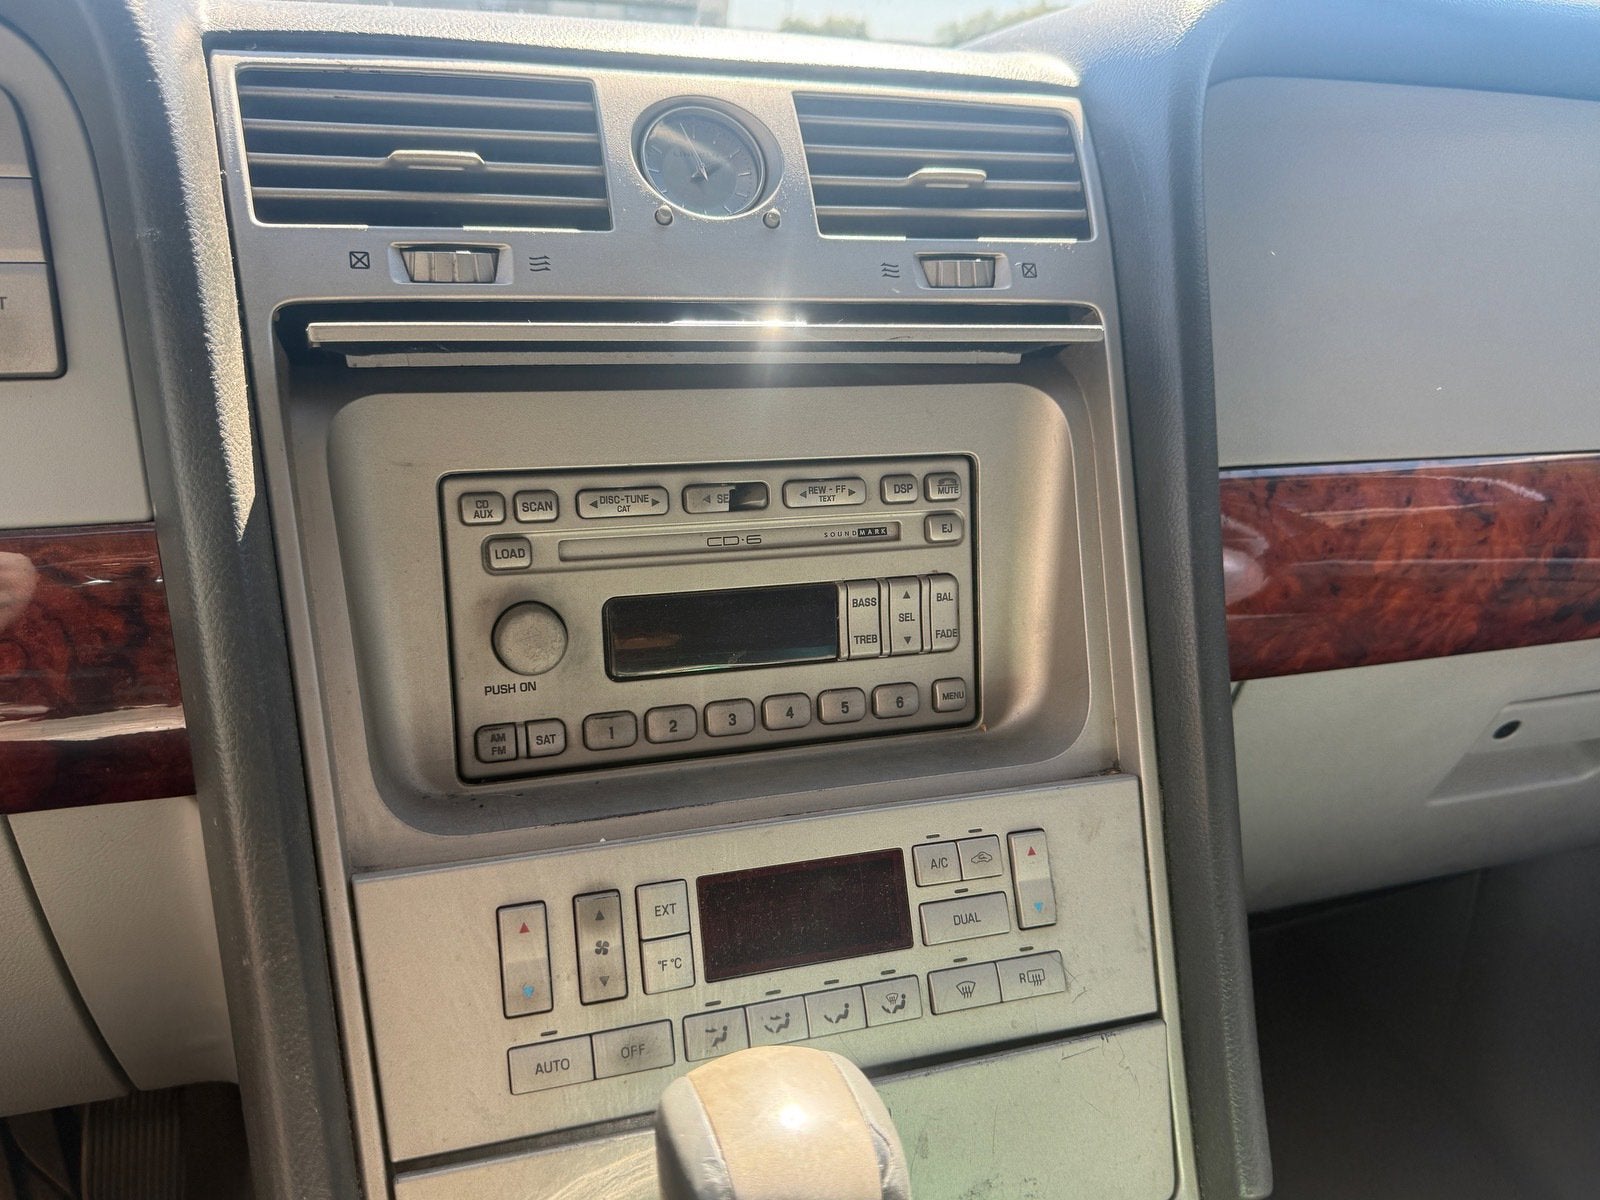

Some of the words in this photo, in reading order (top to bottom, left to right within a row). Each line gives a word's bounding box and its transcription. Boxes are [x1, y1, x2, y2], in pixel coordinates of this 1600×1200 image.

[808, 485, 826, 495] REW
[836, 485, 846, 494] FF
[893, 483, 913, 495] DSP
[937, 486, 959, 495] MUTE
[600, 494, 650, 505] DISC-TUNE
[818, 494, 836, 503] TEXT
[475, 500, 489, 509] CD
[521, 500, 553, 513] SCAN
[617, 504, 632, 513] CAT
[473, 509, 494, 519] AUX
[941, 522, 953, 533] EJ
[494, 548, 526, 560] LOAD
[852, 597, 877, 608] BASS
[936, 592, 954, 602] BAL
[898, 612, 915, 623] SEL
[935, 628, 958, 639] FADE
[853, 634, 878, 645] TREB
[484, 682, 516, 696] PUSH
[519, 681, 537, 693] ON
[942, 690, 965, 701] MENU
[896, 695, 904, 708] 6
[785, 706, 794, 719] 4
[841, 701, 849, 714] 5
[728, 712, 737, 726] 3
[669, 719, 678, 733] 2
[490, 733, 506, 743] AM
[608, 726, 615, 740] 1
[535, 734, 556, 746] SAT
[491, 746, 507, 756] FM
[930, 857, 949, 870] A/C
[654, 903, 677, 917] EXT
[953, 911, 981, 926] DUAL
[620, 1044, 646, 1059] OFF
[535, 1058, 571, 1075] AUTO
